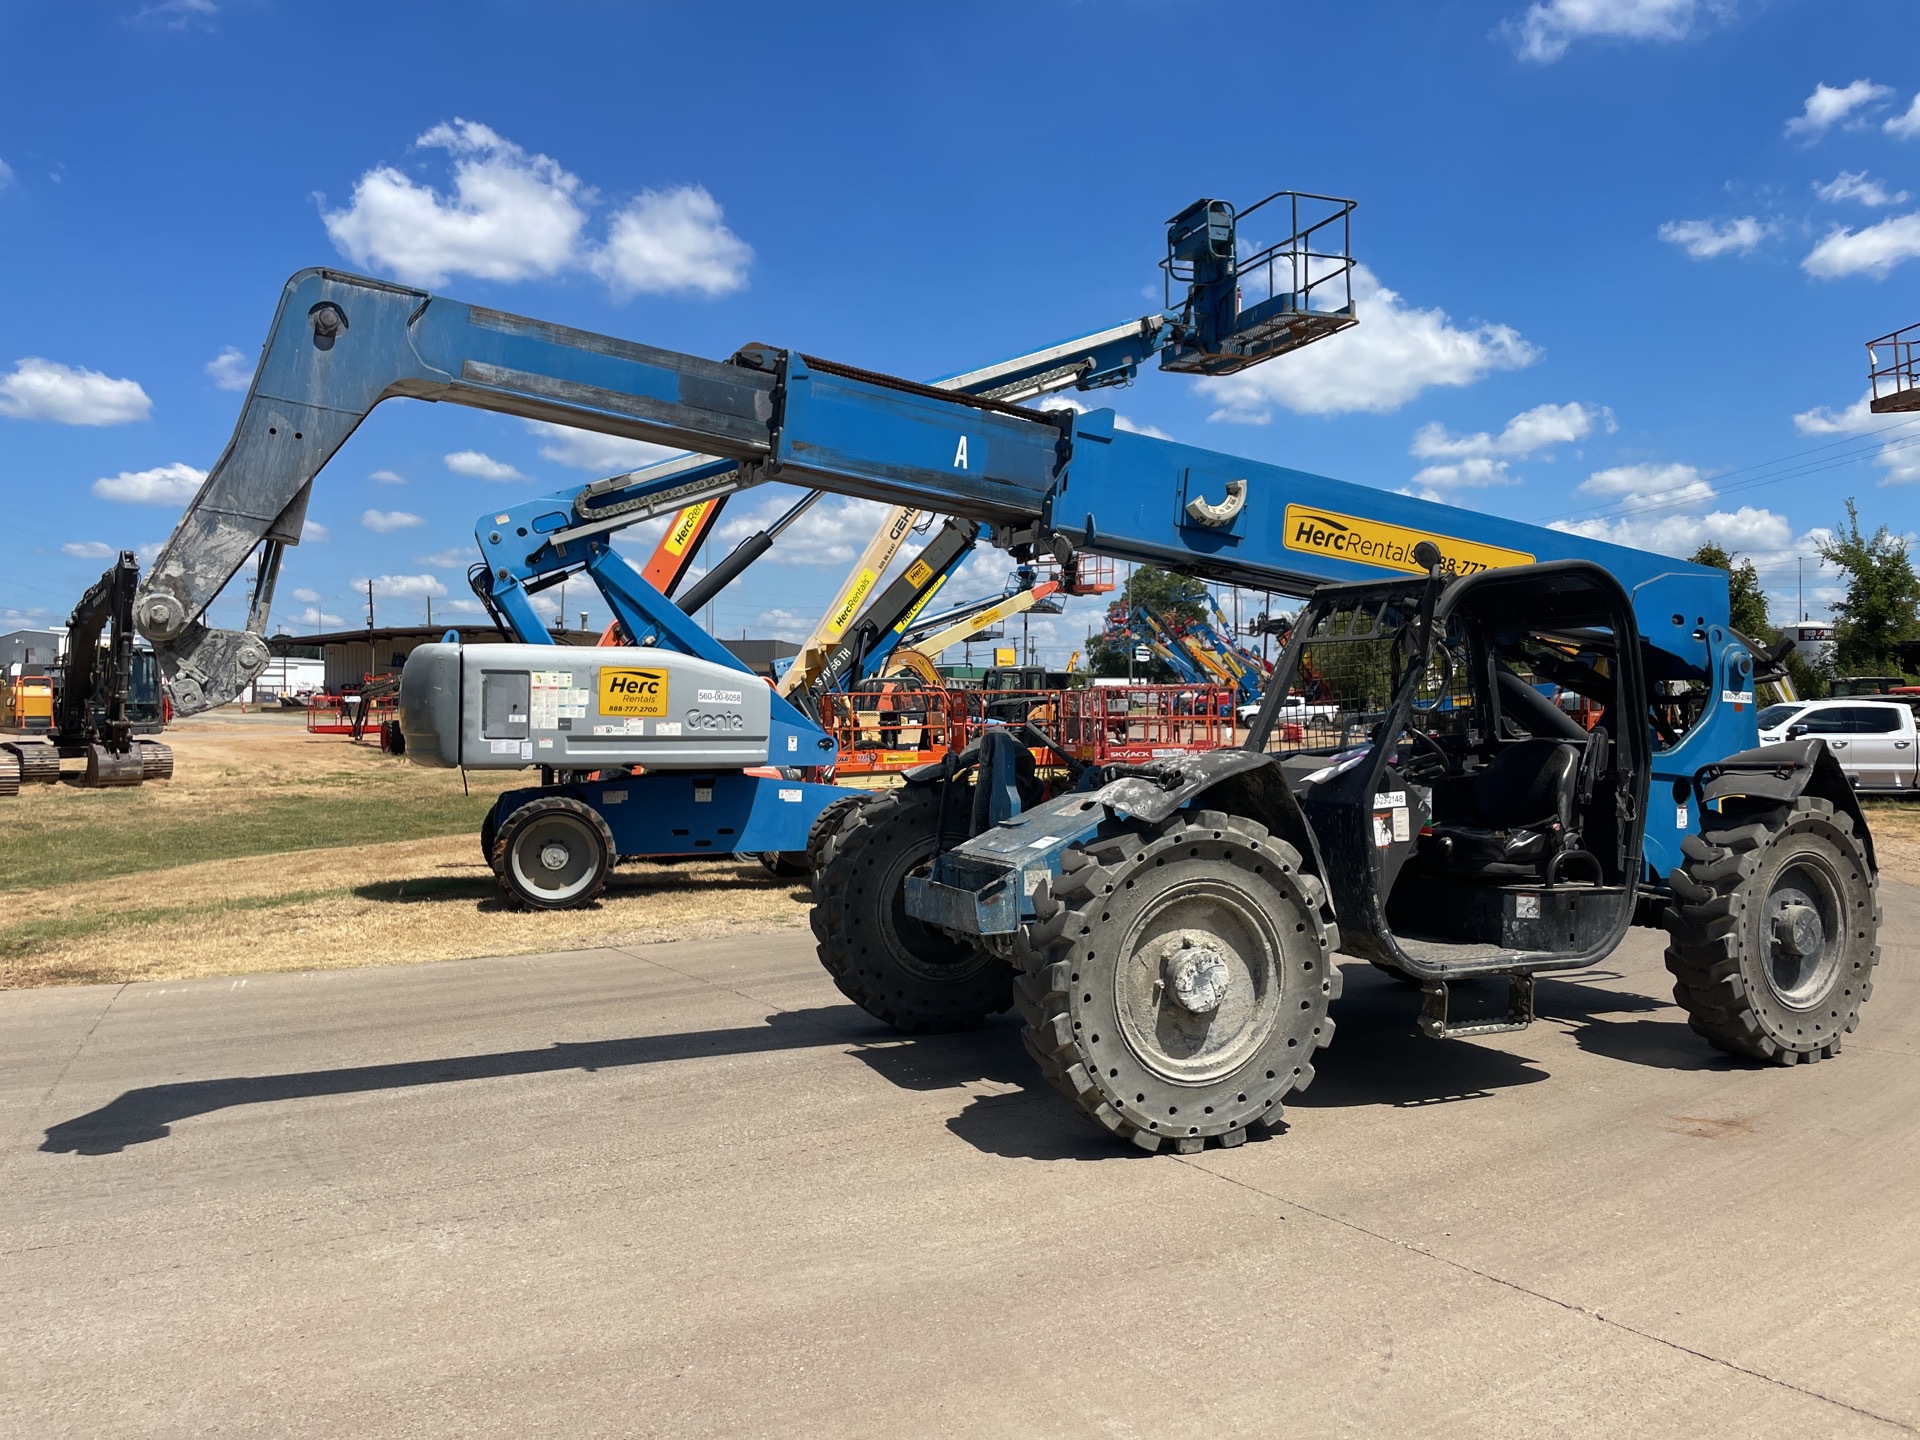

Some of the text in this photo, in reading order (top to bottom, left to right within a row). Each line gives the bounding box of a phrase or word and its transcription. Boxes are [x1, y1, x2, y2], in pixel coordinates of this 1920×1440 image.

[953, 435, 968, 470] A
[1294, 521, 1417, 565] HercRentals
[909, 564, 925, 581] Herc
[835, 579, 870, 628] HercRentals
[838, 647, 852, 661] TH
[609, 677, 660, 694] Herc
[622, 694, 657, 704] Rentals
[699, 692, 741, 702] 560-00-6058
[608, 705, 658, 713] 888-777-2700
[684, 708, 743, 731] Genie
[1110, 749, 1150, 758] SKYJACK
